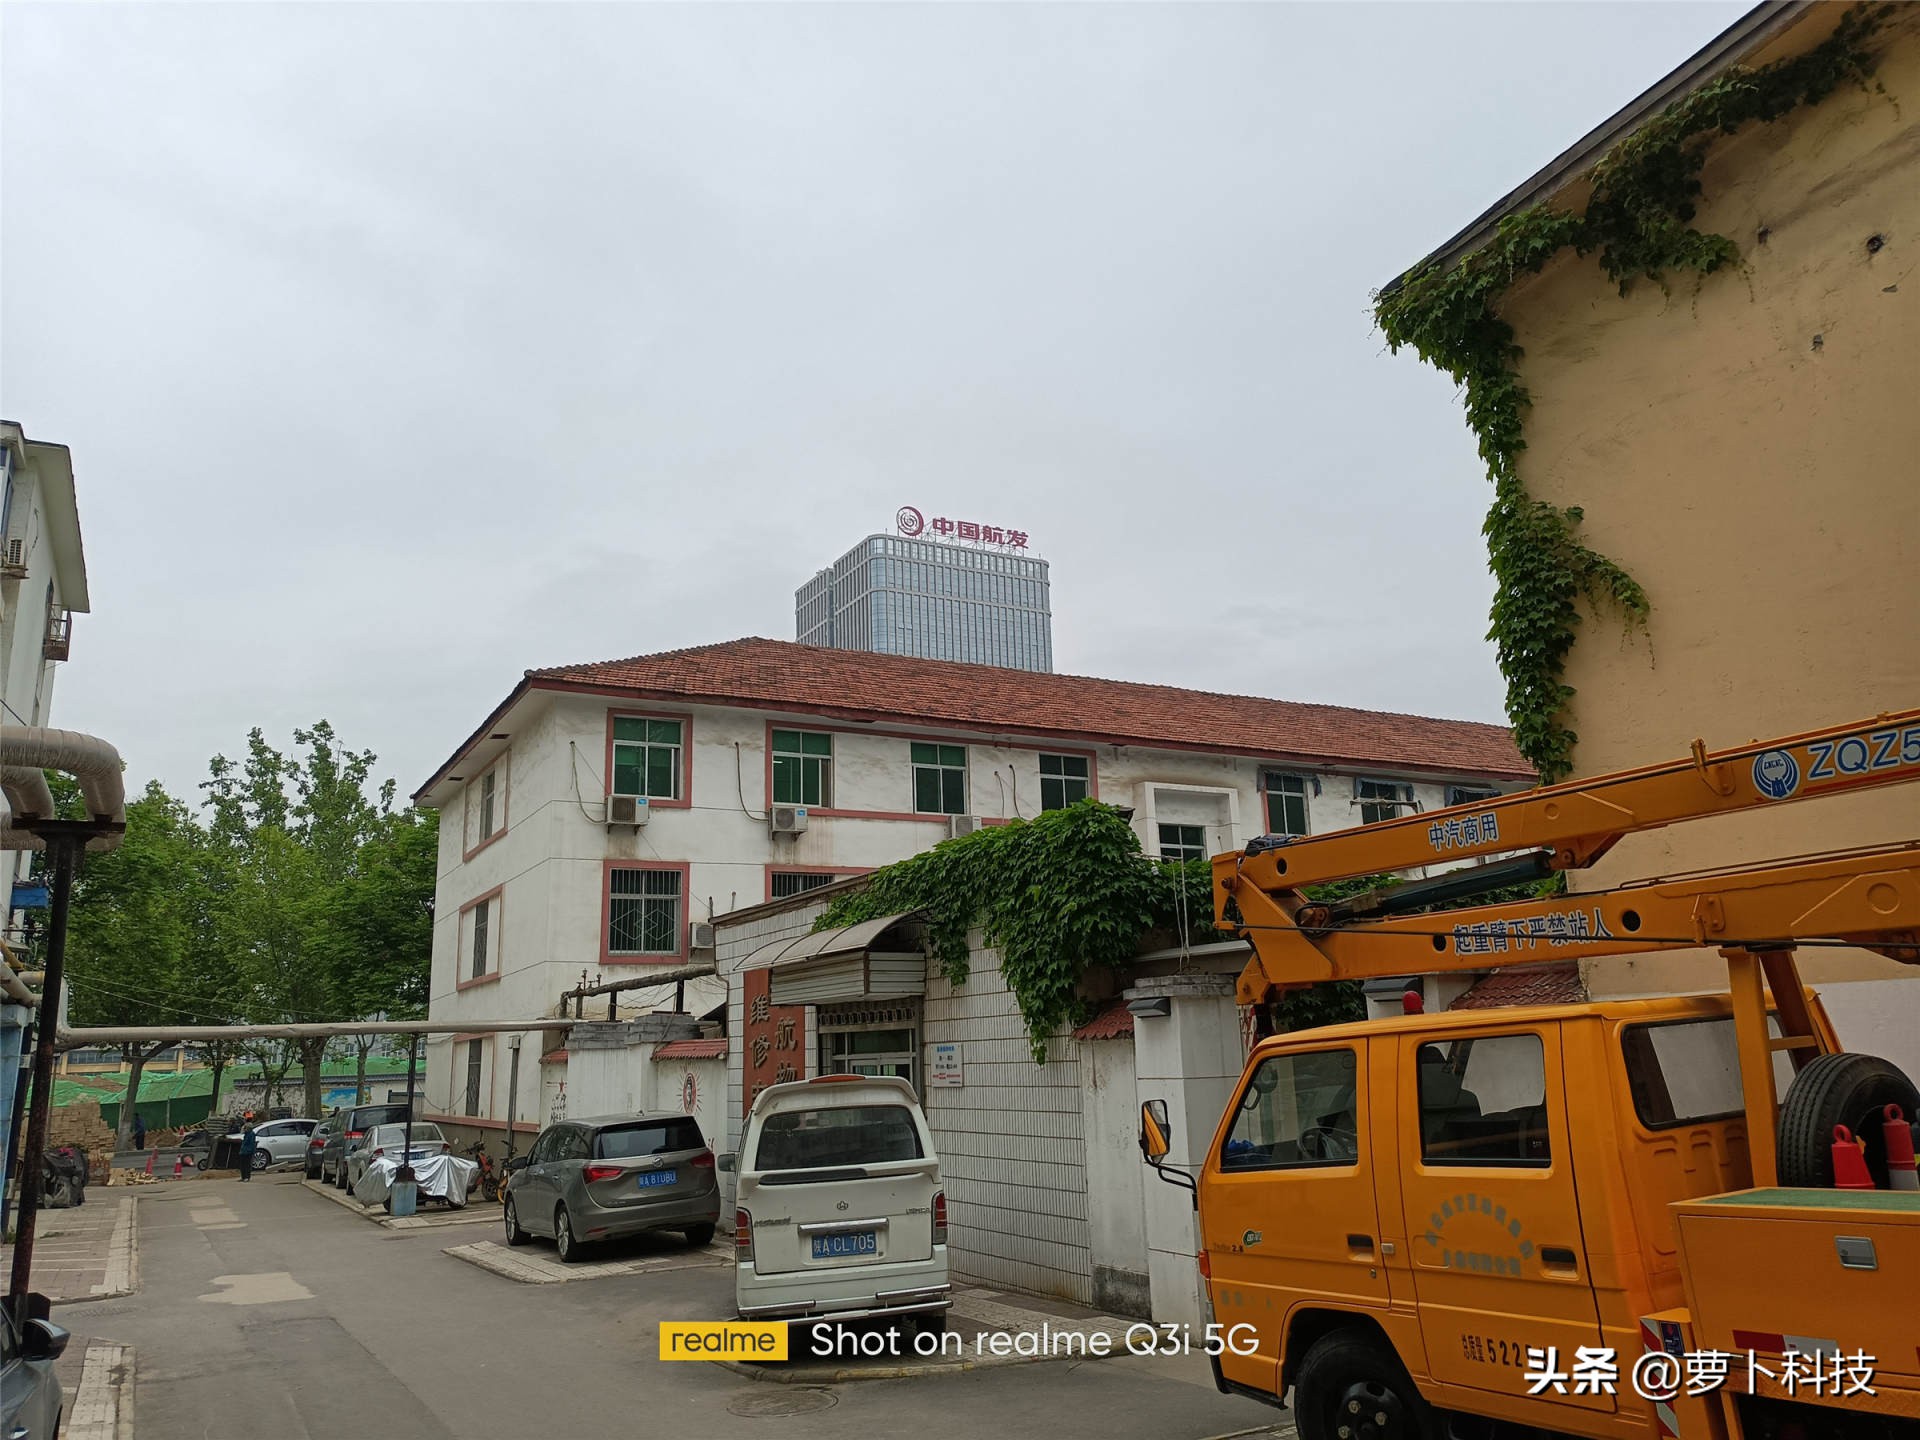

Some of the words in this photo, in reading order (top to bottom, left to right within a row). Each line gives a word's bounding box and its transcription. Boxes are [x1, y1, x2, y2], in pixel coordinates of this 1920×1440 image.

[932, 517, 1029, 549] 中国航发
[1807, 727, 1920, 780] ZQZ5
[1428, 812, 1499, 852] 中汽商用
[1454, 907, 1613, 954] 起重臂下严禁站人
